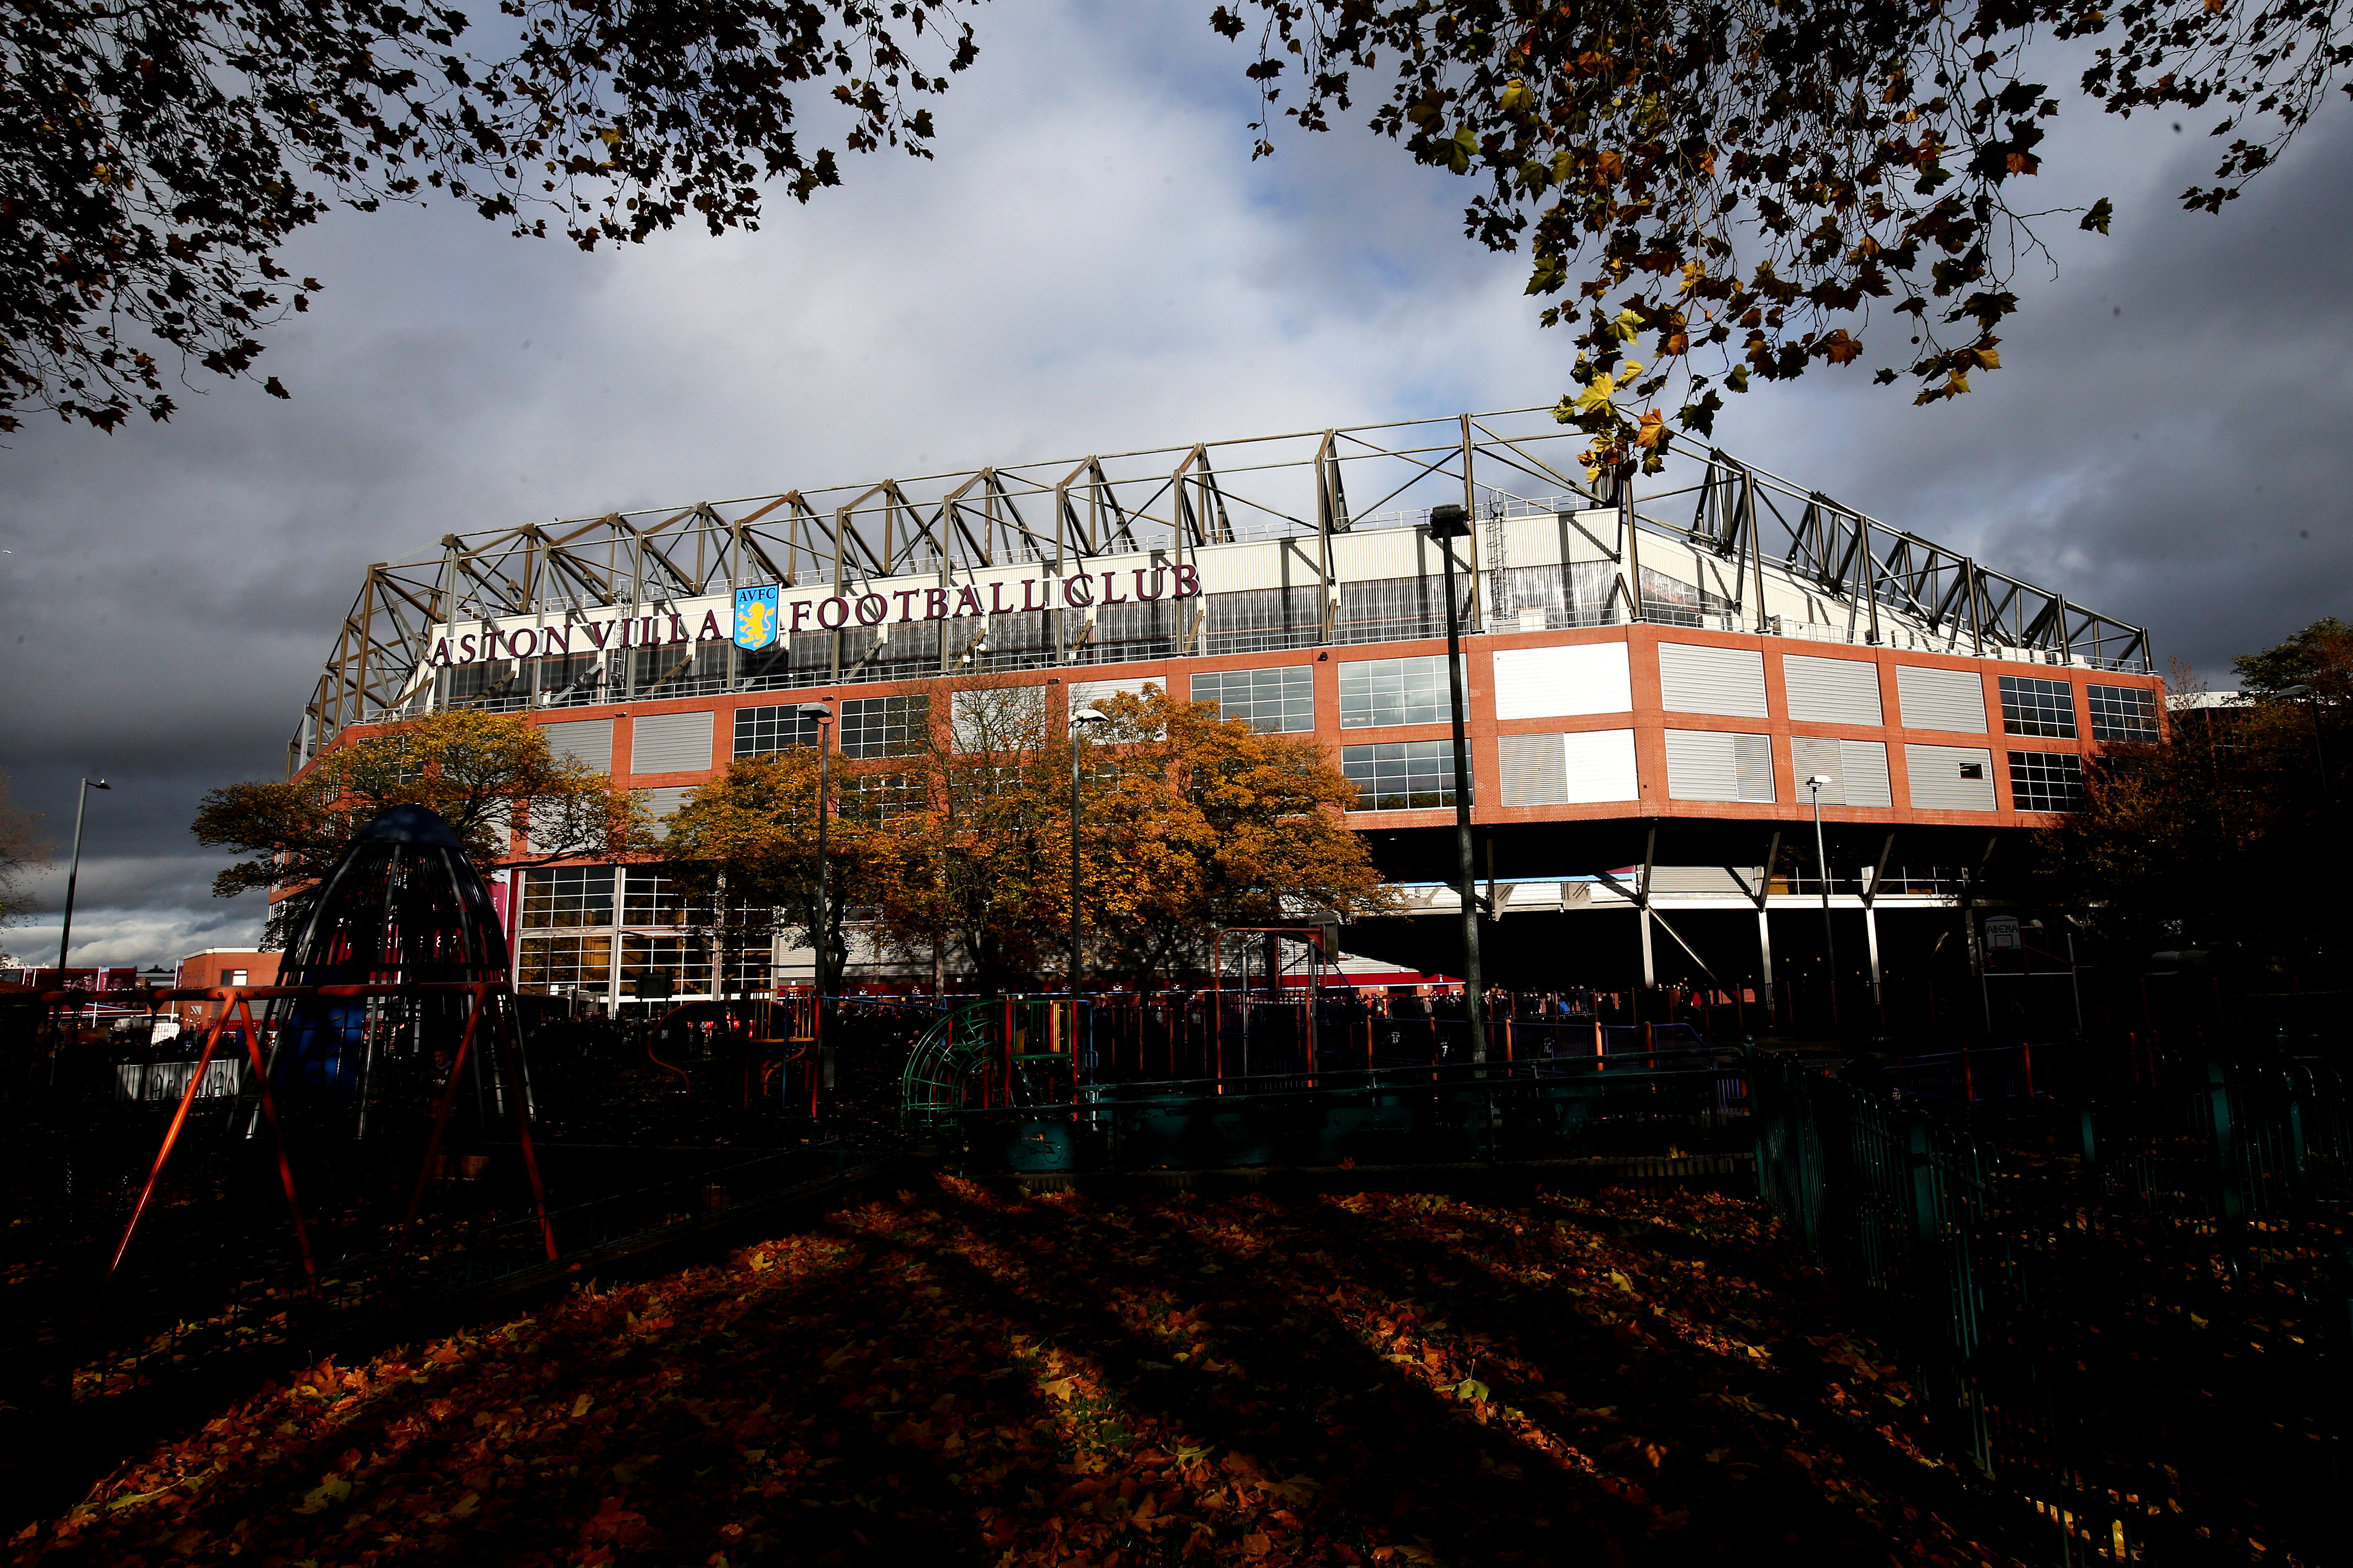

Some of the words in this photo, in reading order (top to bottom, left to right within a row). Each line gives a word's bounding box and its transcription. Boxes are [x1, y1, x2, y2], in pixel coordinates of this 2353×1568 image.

[738, 586, 776, 602] AVFC
[789, 579, 1047, 632] FOOTBALL
[1064, 564, 1200, 607] CLUB
[430, 624, 574, 667] ASTON
[590, 609, 724, 650] VILLA
[1987, 924, 2018, 934] ARENA
